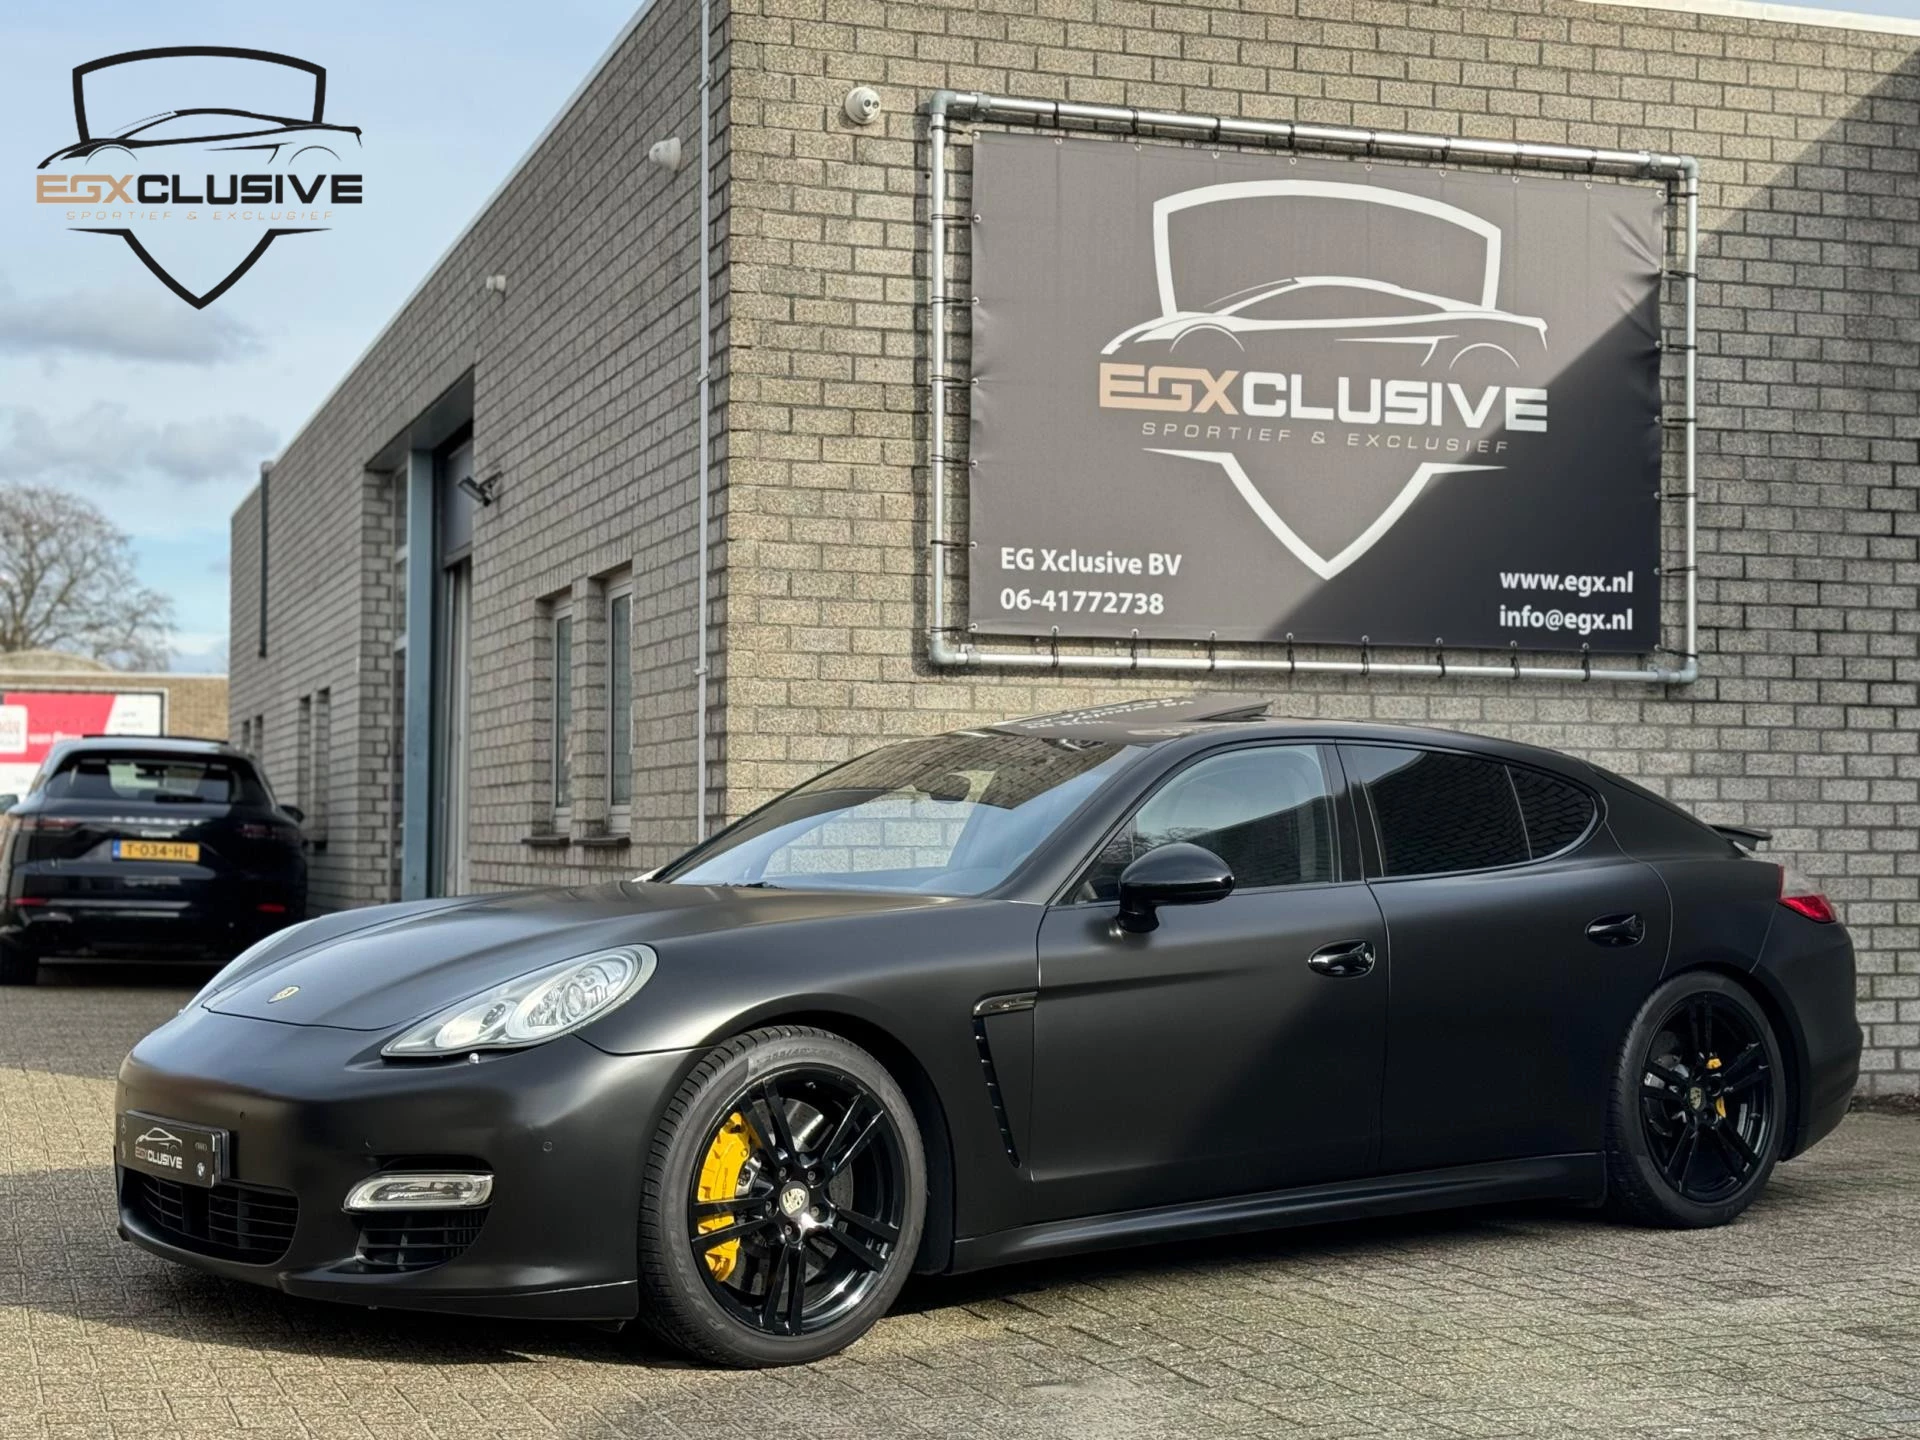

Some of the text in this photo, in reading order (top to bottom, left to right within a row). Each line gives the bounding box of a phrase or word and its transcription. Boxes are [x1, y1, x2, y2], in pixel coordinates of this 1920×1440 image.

[1099, 362, 1548, 433] EGXCLUSIVE
[1140, 421, 1510, 454] SPORTIEF & EXCLUSIEF
[1001, 546, 1182, 576] EG Xclusive BV
[1500, 570, 1634, 597] www.egx.nl
[1000, 588, 1164, 615] 06-41772738
[1500, 604, 1633, 635] info@egx.nl
